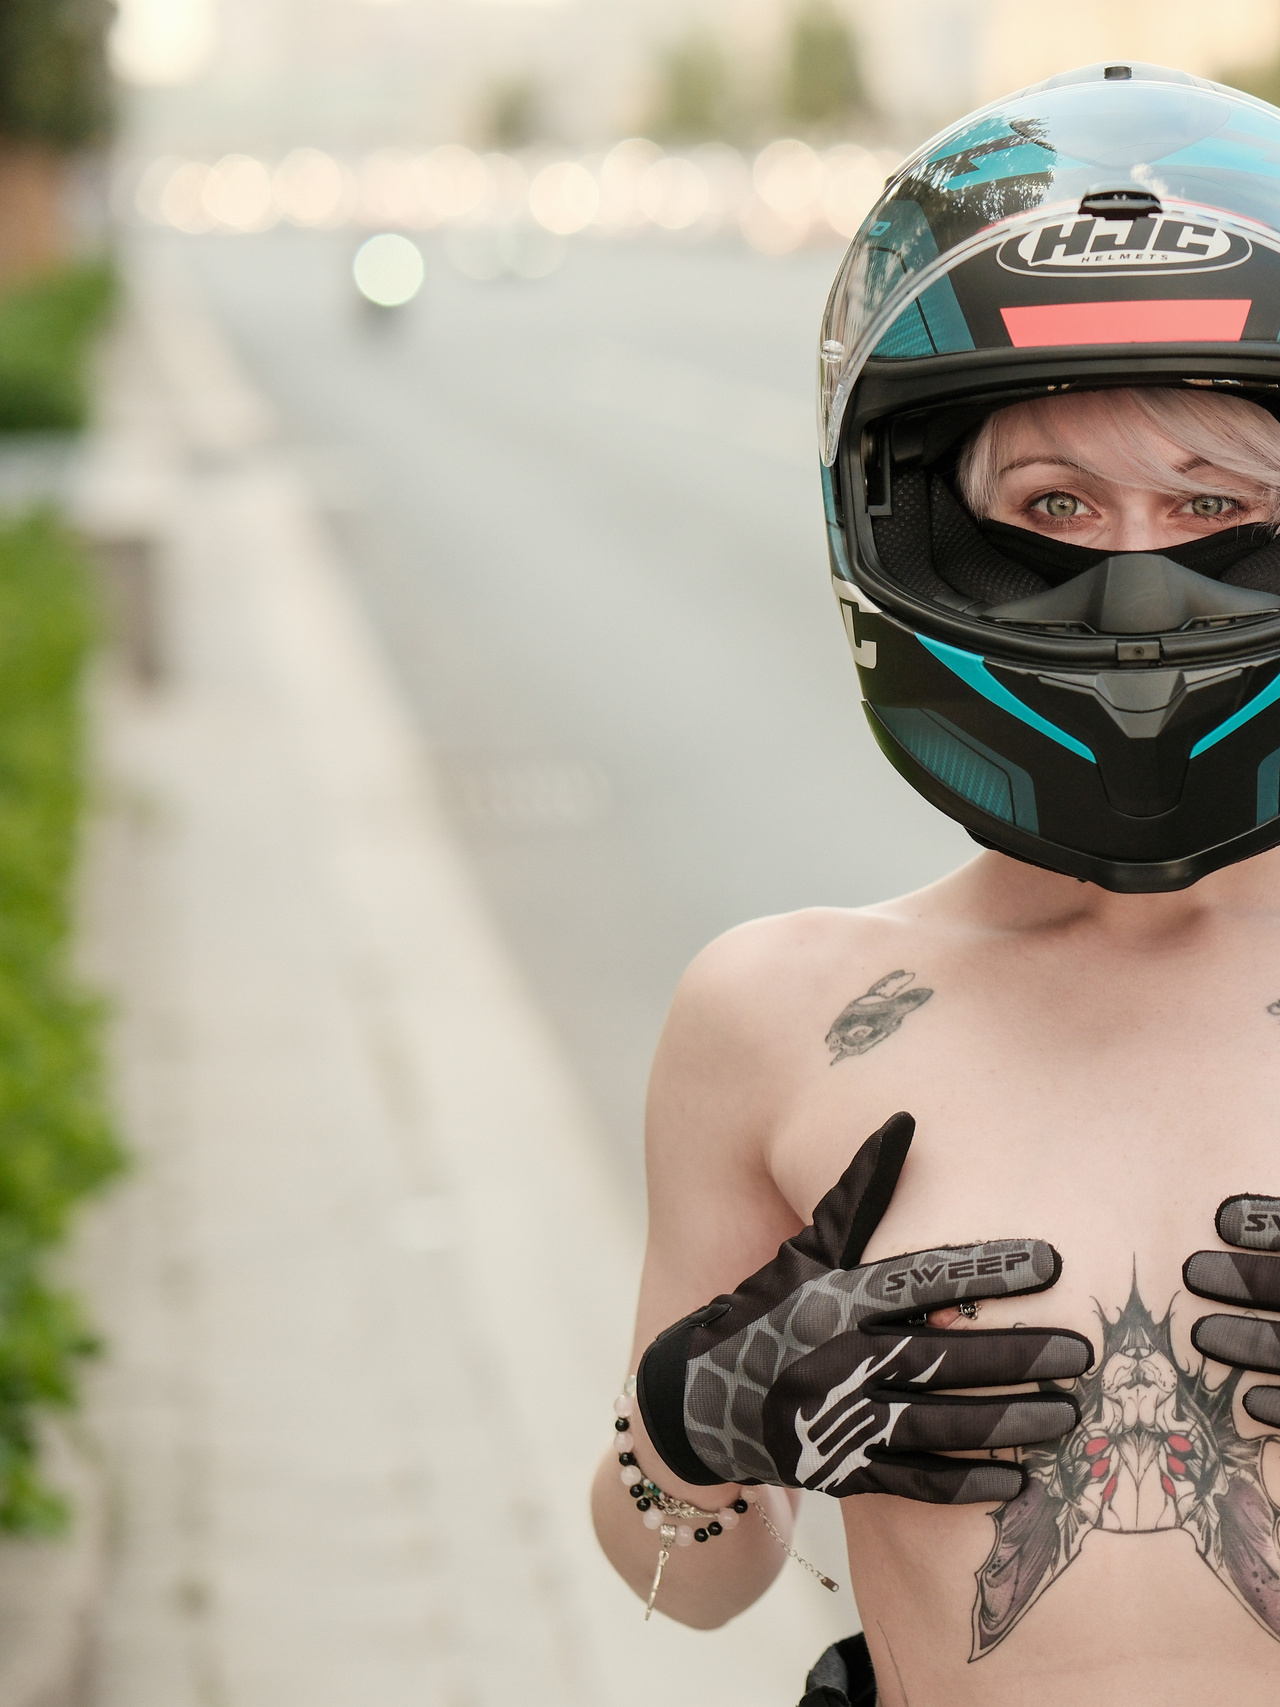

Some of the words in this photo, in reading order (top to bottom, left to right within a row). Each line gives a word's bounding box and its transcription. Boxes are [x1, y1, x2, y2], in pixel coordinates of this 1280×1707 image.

[1031, 217, 1217, 263] HJC
[1081, 253, 1168, 264] HELMETS
[885, 1251, 1031, 1293] SWEEP
